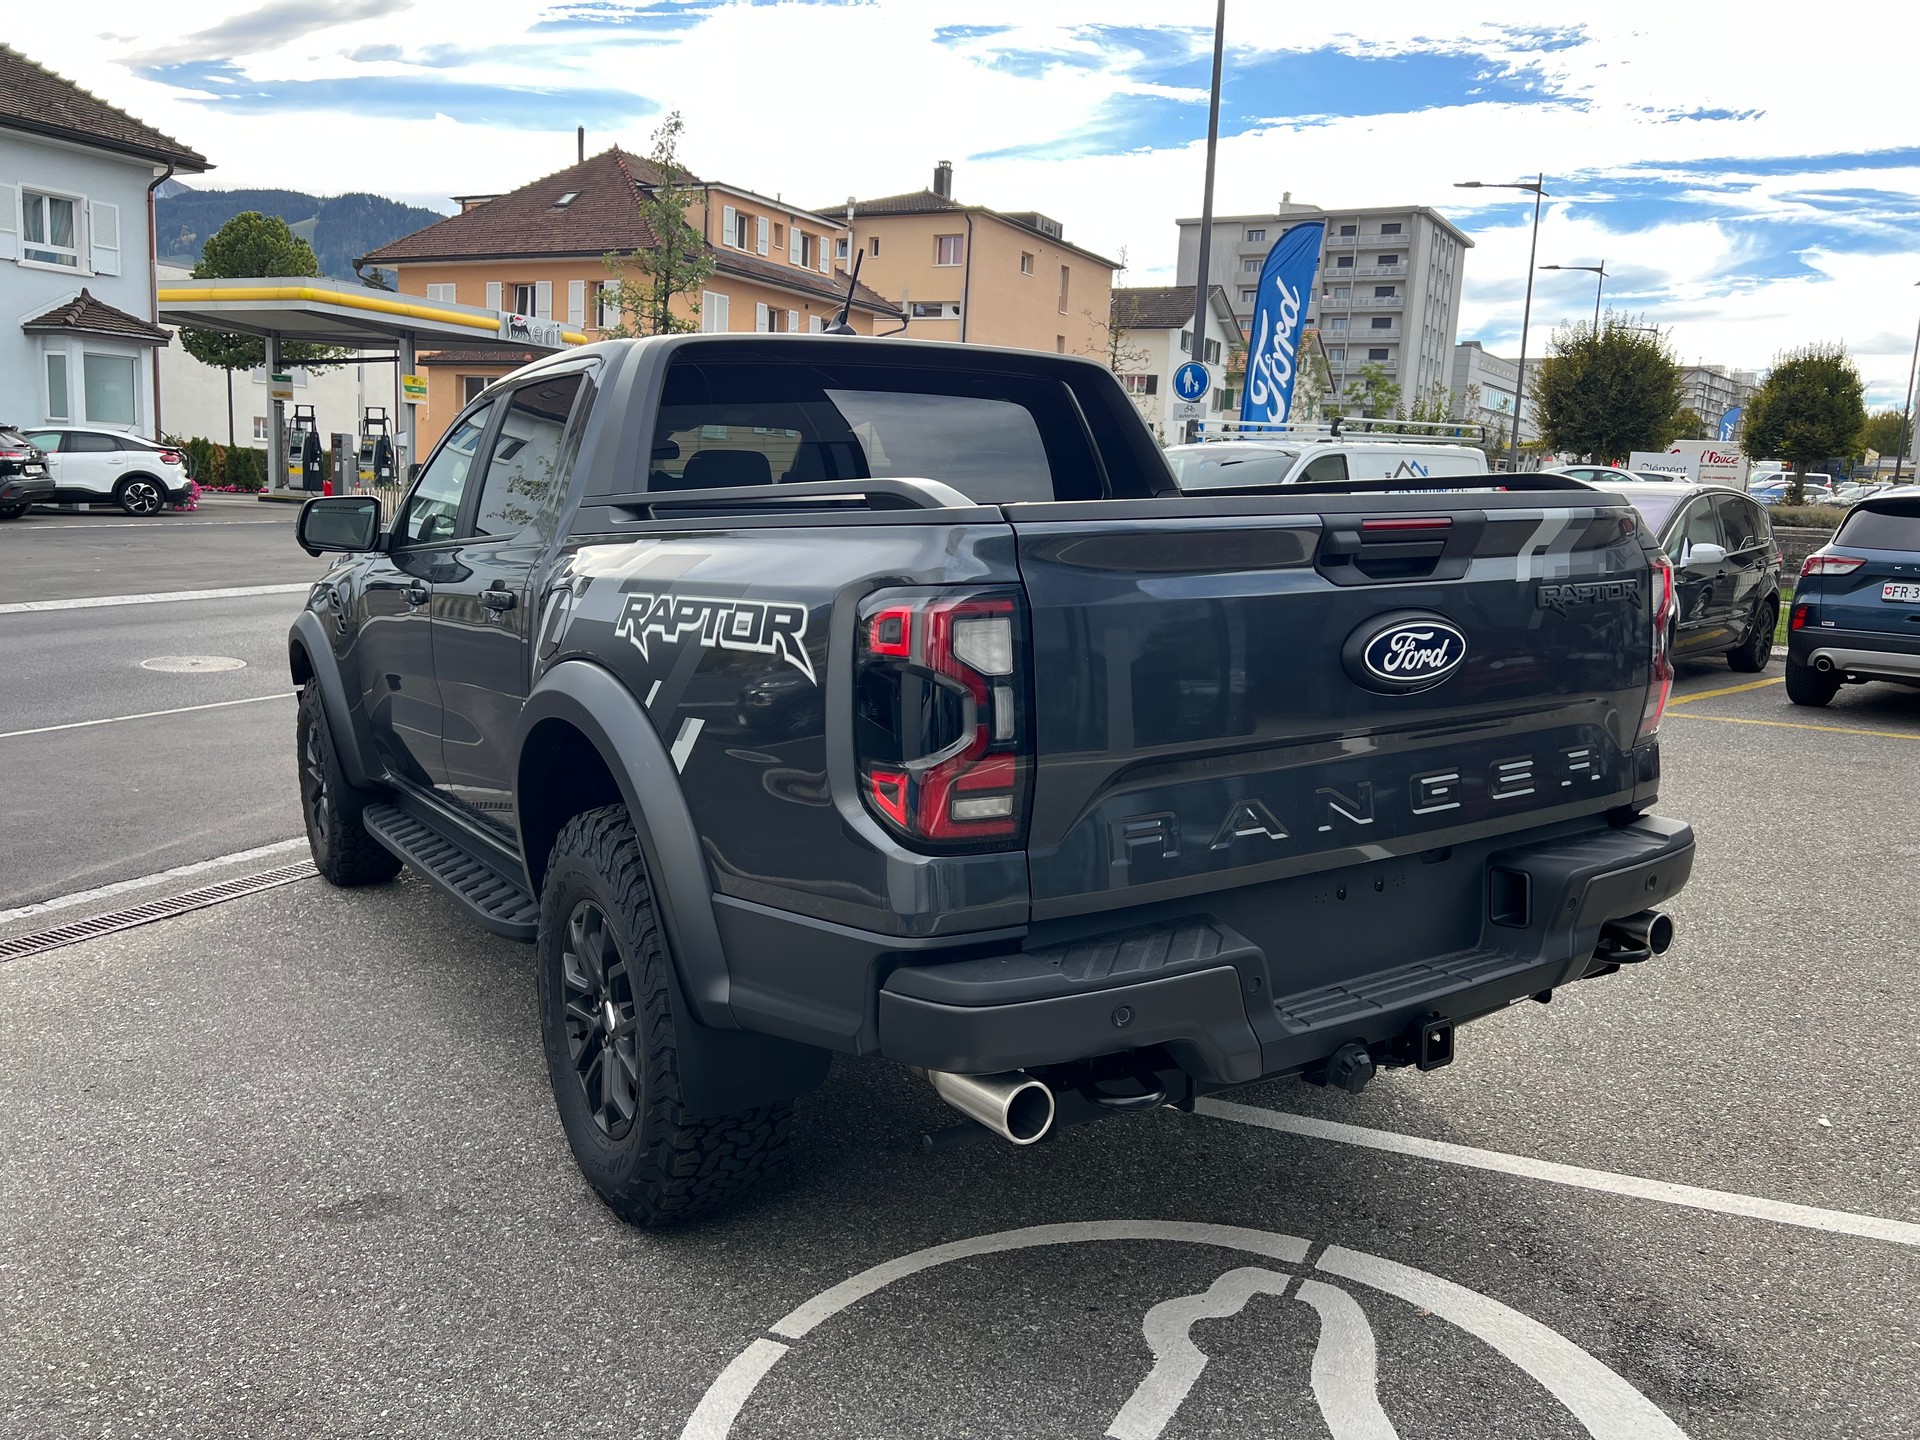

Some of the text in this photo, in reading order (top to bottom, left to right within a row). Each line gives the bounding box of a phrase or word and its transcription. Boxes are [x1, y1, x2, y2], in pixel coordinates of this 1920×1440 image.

[531, 323, 560, 346] eni
[1250, 275, 1301, 424] Ford
[1537, 578, 1643, 618] RAPTOR
[614, 592, 818, 688] RAPTOR
[1382, 631, 1451, 673] Ford
[1106, 743, 1601, 867] RANGER
